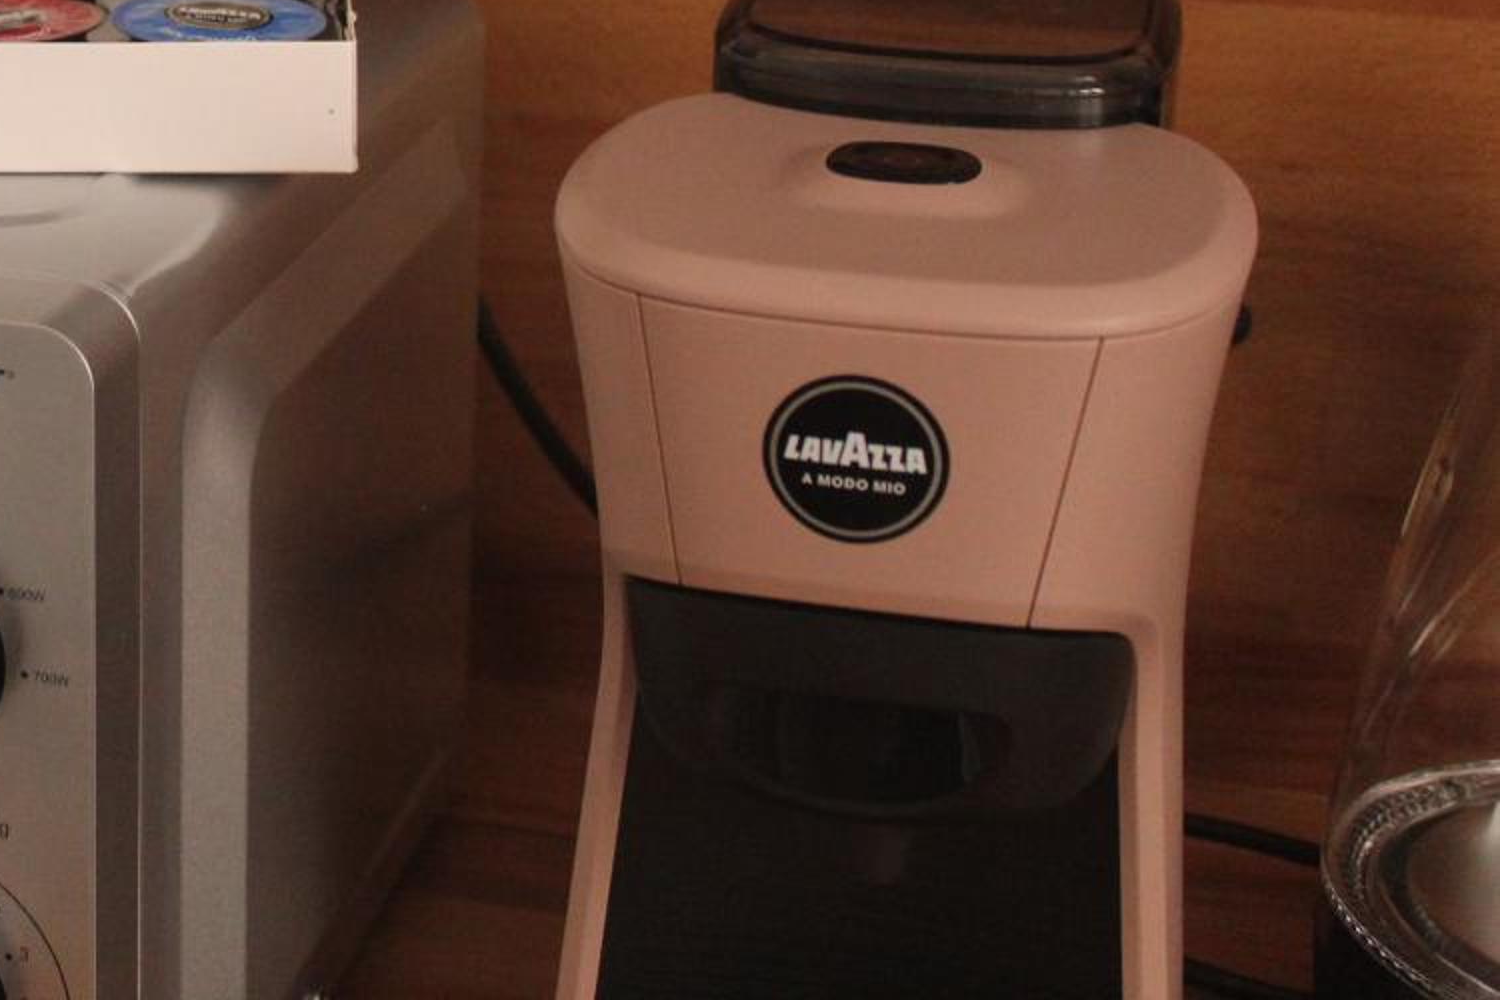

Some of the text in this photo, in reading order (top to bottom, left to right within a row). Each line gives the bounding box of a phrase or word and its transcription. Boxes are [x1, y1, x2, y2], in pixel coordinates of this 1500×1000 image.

[782, 431, 929, 475] LAVAZZA
[801, 472, 907, 496] A MODO MIO
[7, 585, 45, 603] 600W
[33, 668, 70, 688] 700W
[19, 947, 30, 963] 3
